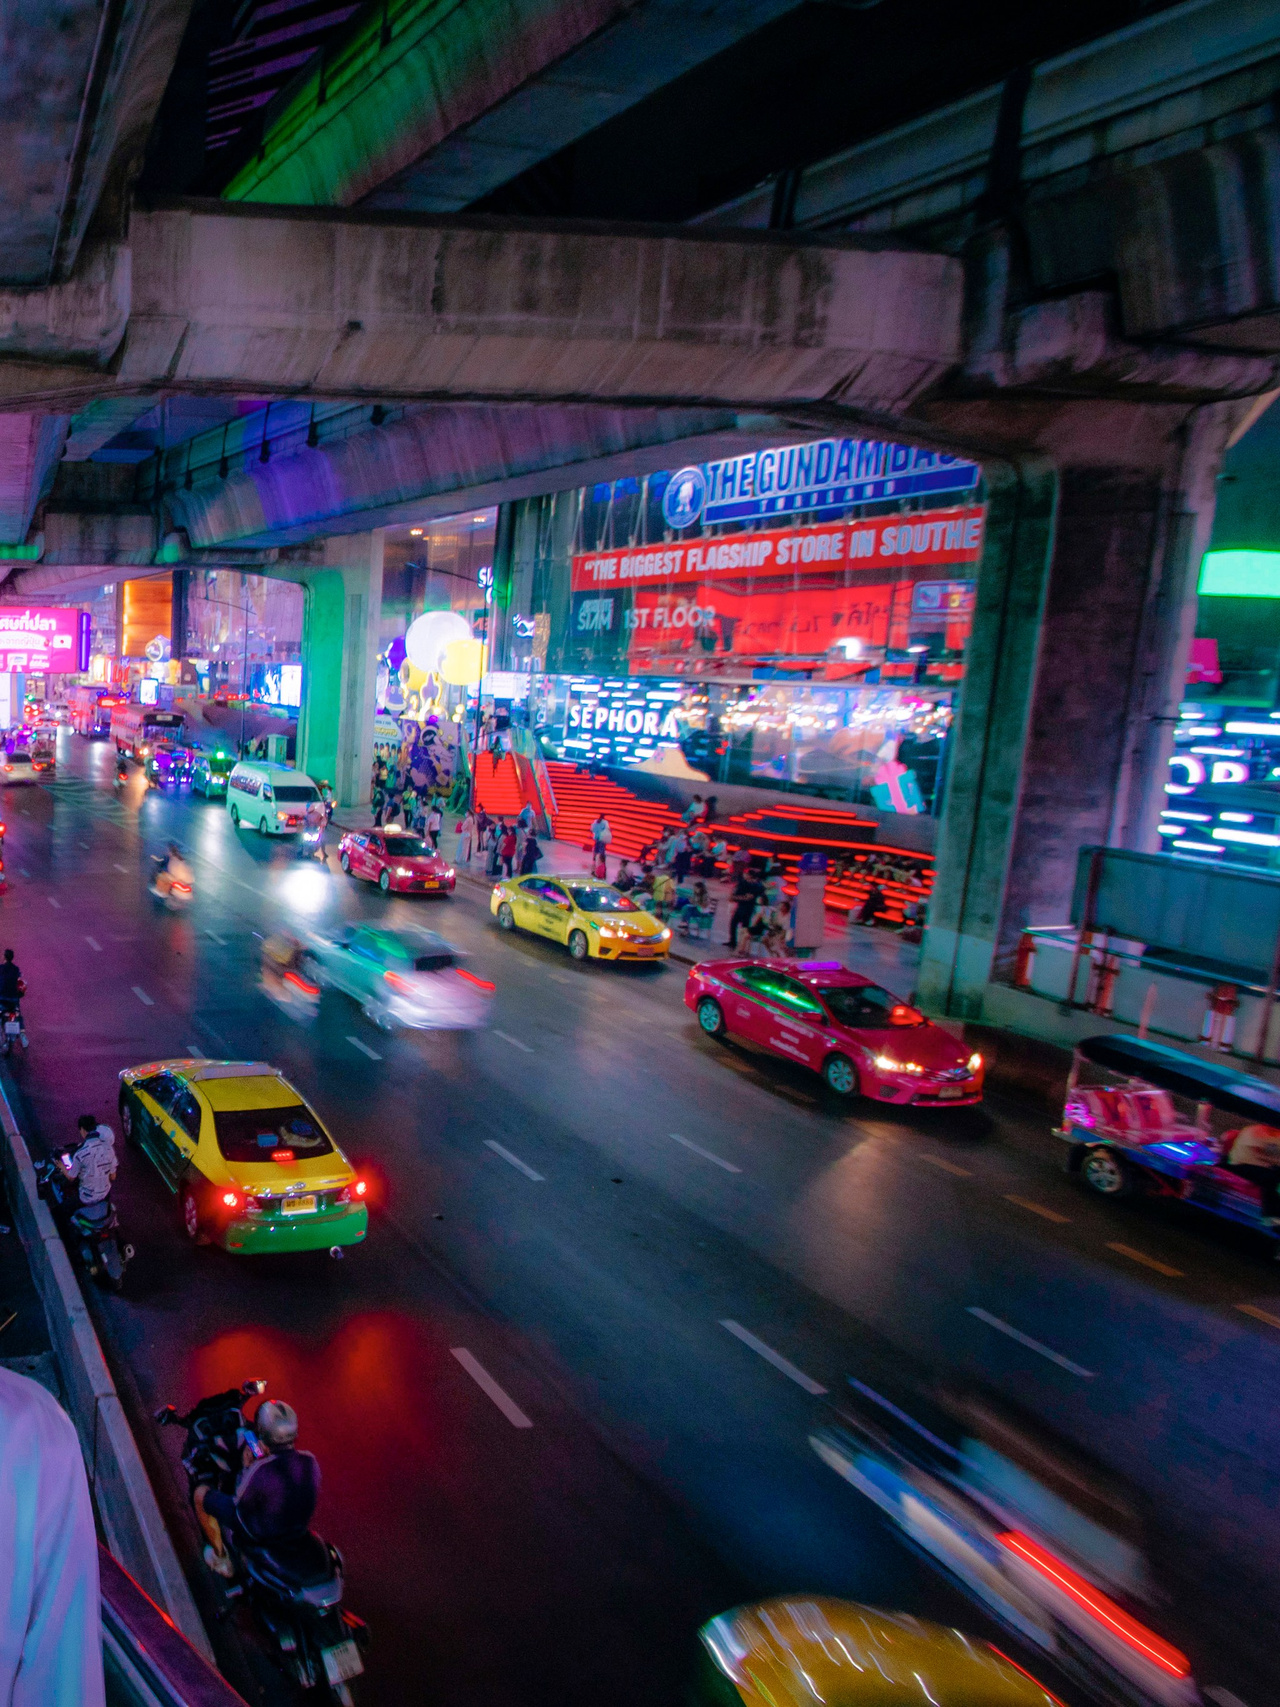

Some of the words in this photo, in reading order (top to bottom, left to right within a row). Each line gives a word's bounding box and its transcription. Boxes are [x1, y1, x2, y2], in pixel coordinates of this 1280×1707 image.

[709, 456, 755, 501] THE
[754, 439, 888, 495] GUNDAM
[619, 549, 684, 579] BIGGEST
[686, 540, 773, 572] FLAGSHIP
[775, 532, 845, 565] STORE
[850, 529, 877, 559] IN
[880, 517, 982, 556] SOUTHE
[624, 608, 651, 629] 1ST
[652, 605, 716, 629] FLOOR
[569, 705, 679, 738] SEPHORA
